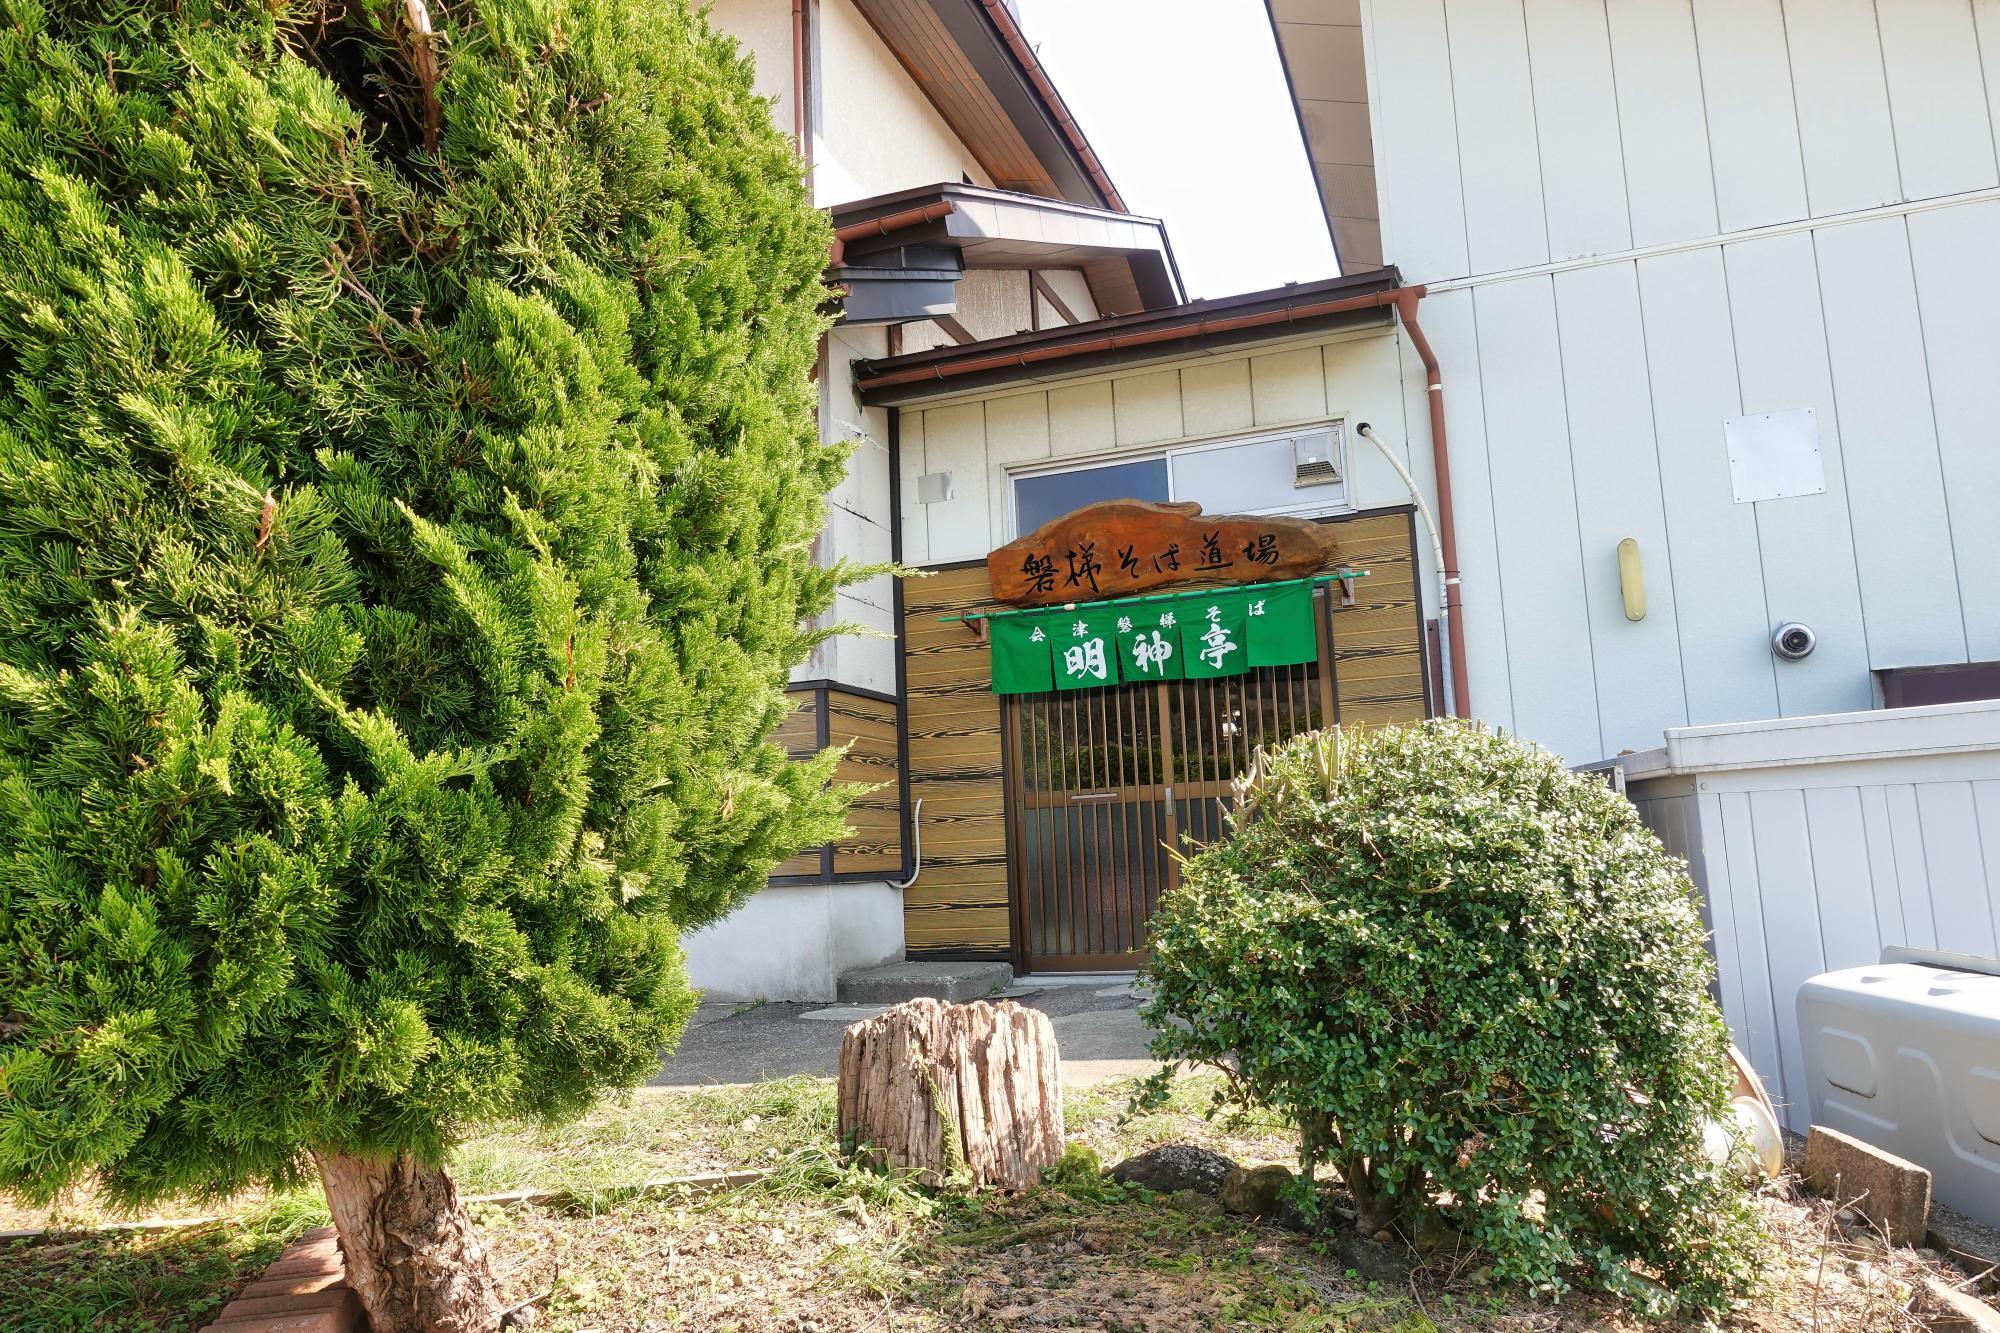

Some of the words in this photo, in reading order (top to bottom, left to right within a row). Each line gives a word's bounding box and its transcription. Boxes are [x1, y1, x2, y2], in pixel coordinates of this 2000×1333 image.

[1019, 531, 1280, 595] 磐梯そば道場
[1029, 600, 1266, 643] 会津磐梯そば
[1063, 625, 1238, 680] 明神亭
